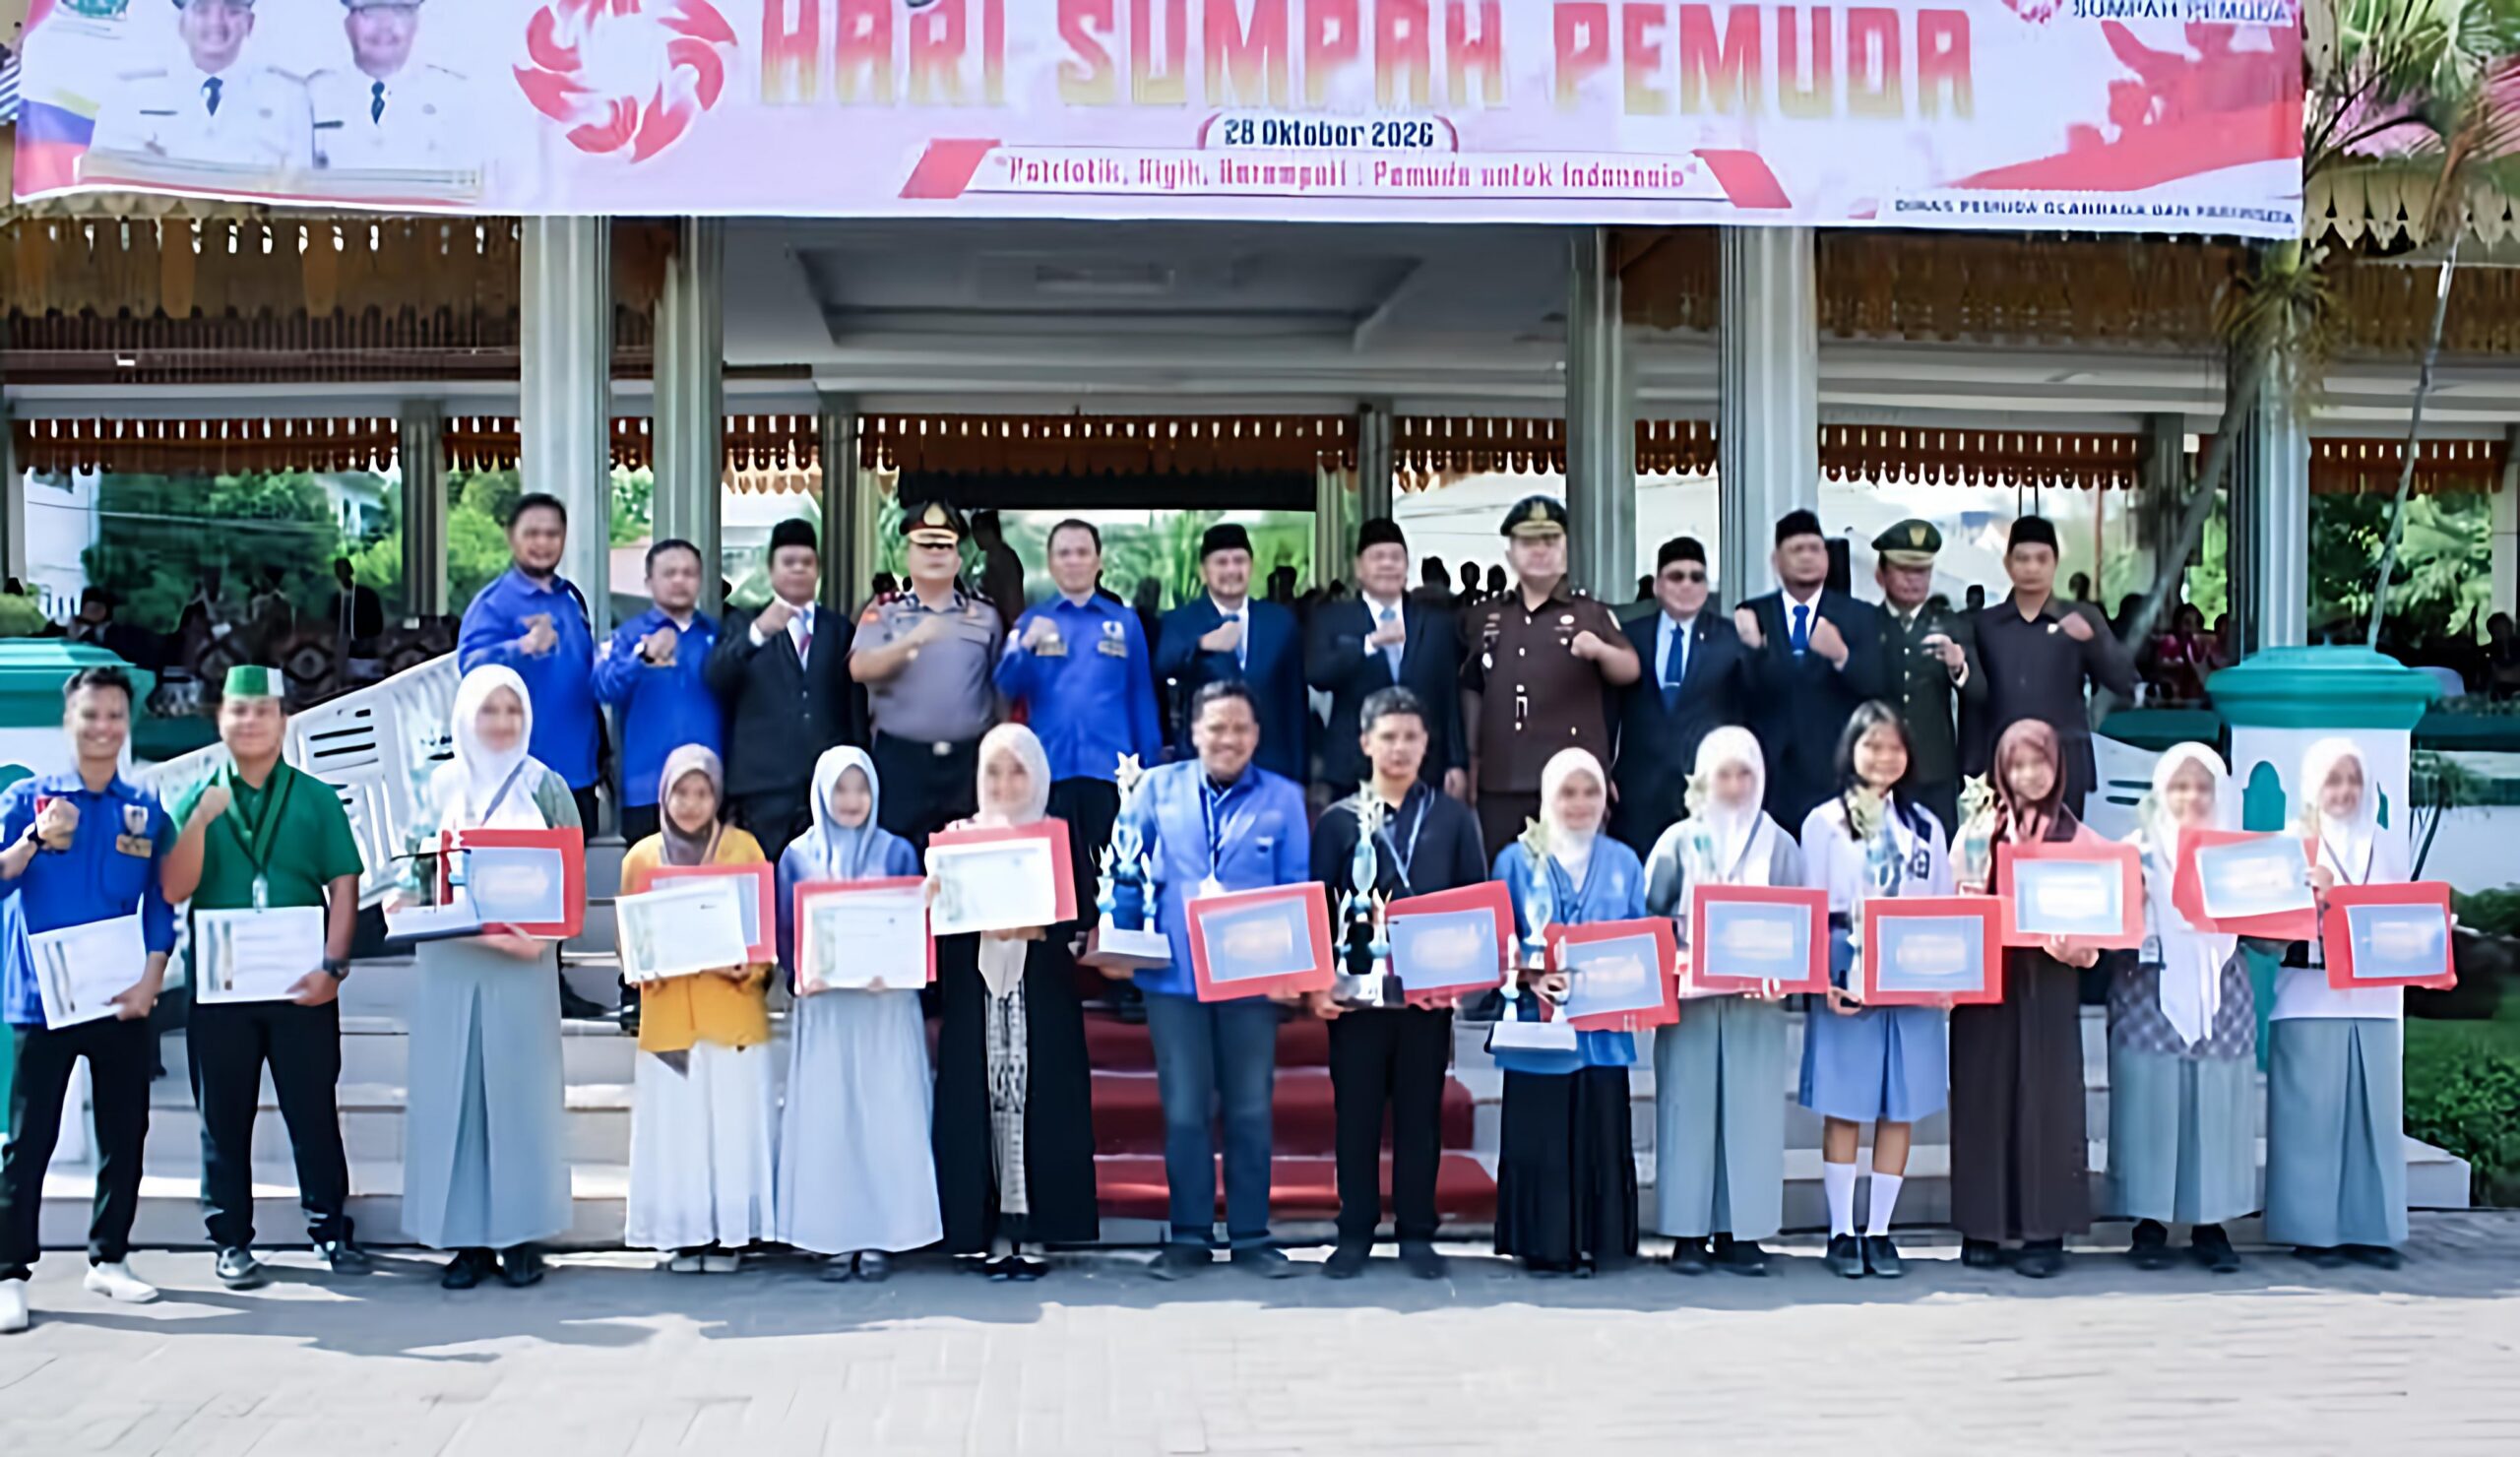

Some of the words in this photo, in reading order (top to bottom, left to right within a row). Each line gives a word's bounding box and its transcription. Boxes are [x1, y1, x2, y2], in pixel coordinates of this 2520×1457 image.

[759, 0, 1006, 105] HARI
[1056, 0, 1504, 108] SUMPAH
[1552, 2, 1975, 118] PEMUDA
[1224, 119, 1255, 146] 28
